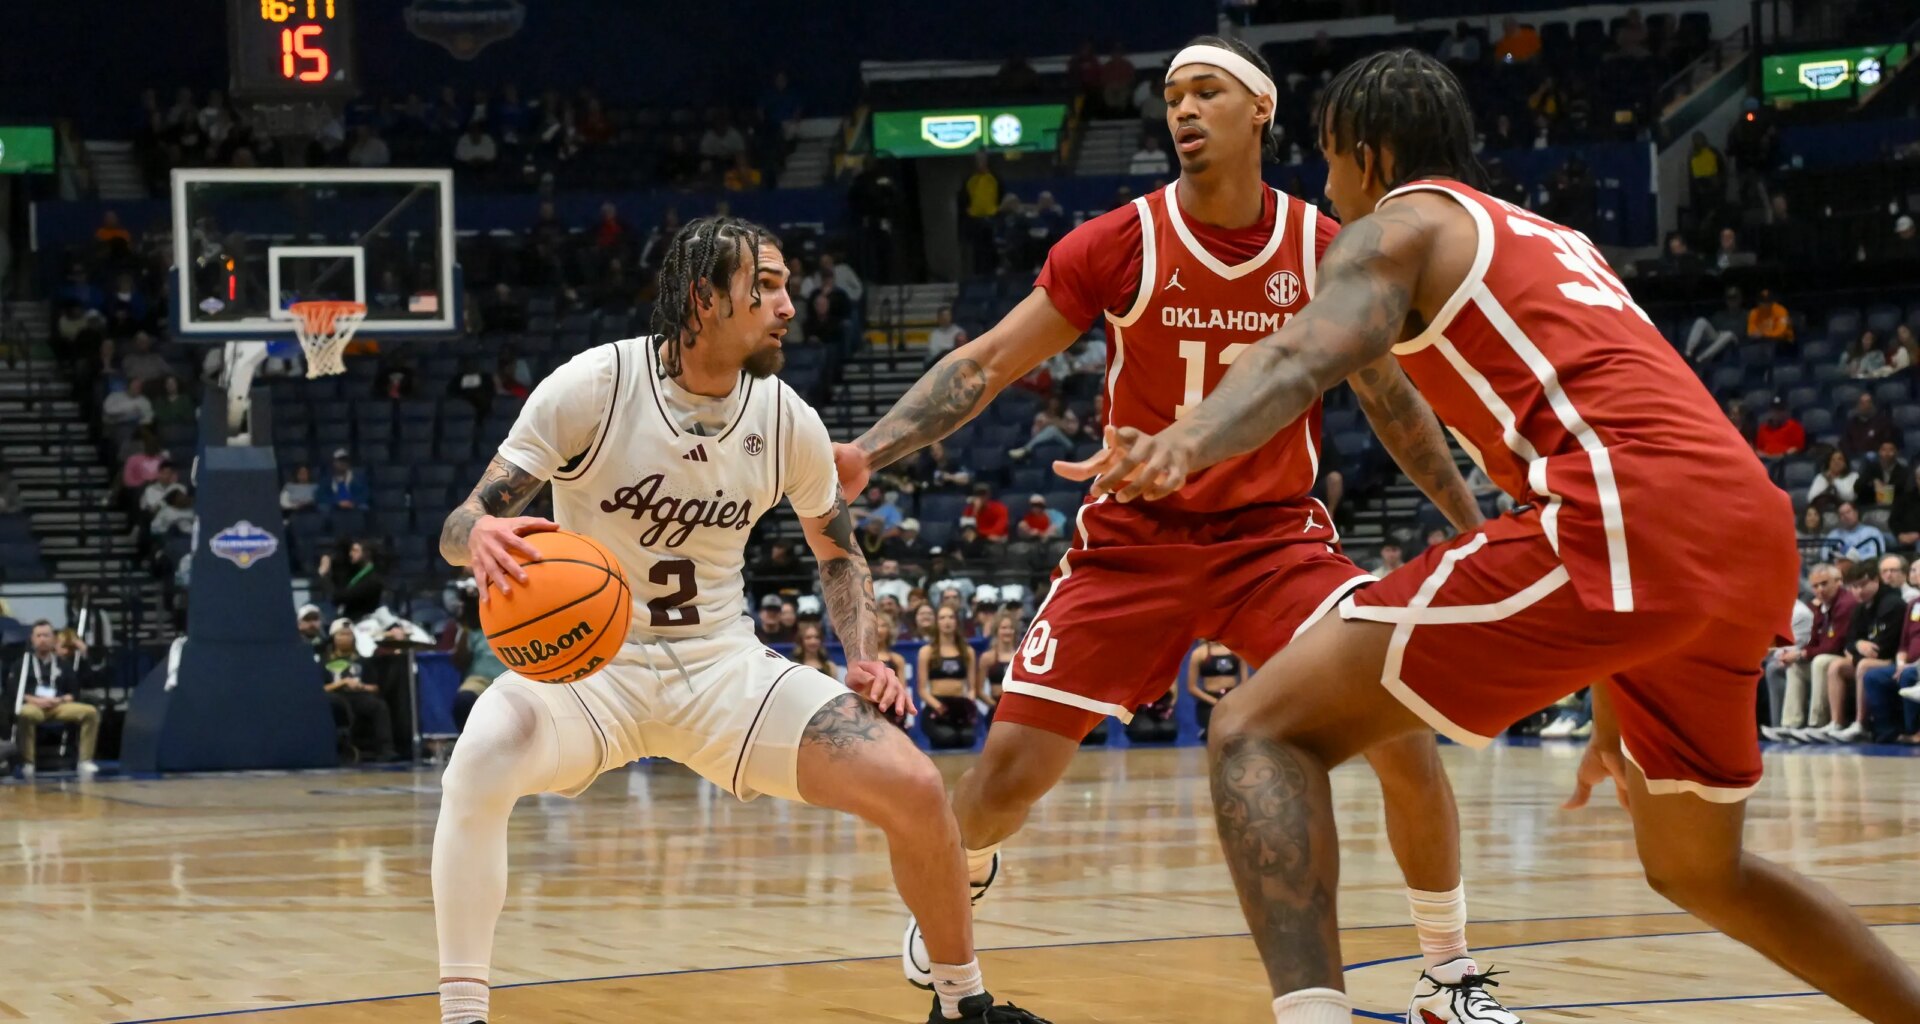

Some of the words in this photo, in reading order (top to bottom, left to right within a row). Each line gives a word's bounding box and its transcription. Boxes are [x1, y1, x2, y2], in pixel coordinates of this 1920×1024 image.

[282, 25, 329, 81] 15
[1268, 271, 1299, 304] SEC
[746, 435, 761, 454] SEC
[600, 473, 752, 547] Aggies
[647, 559, 700, 627] 2
[496, 621, 594, 667] Wilson
[1022, 619, 1058, 675] OU
